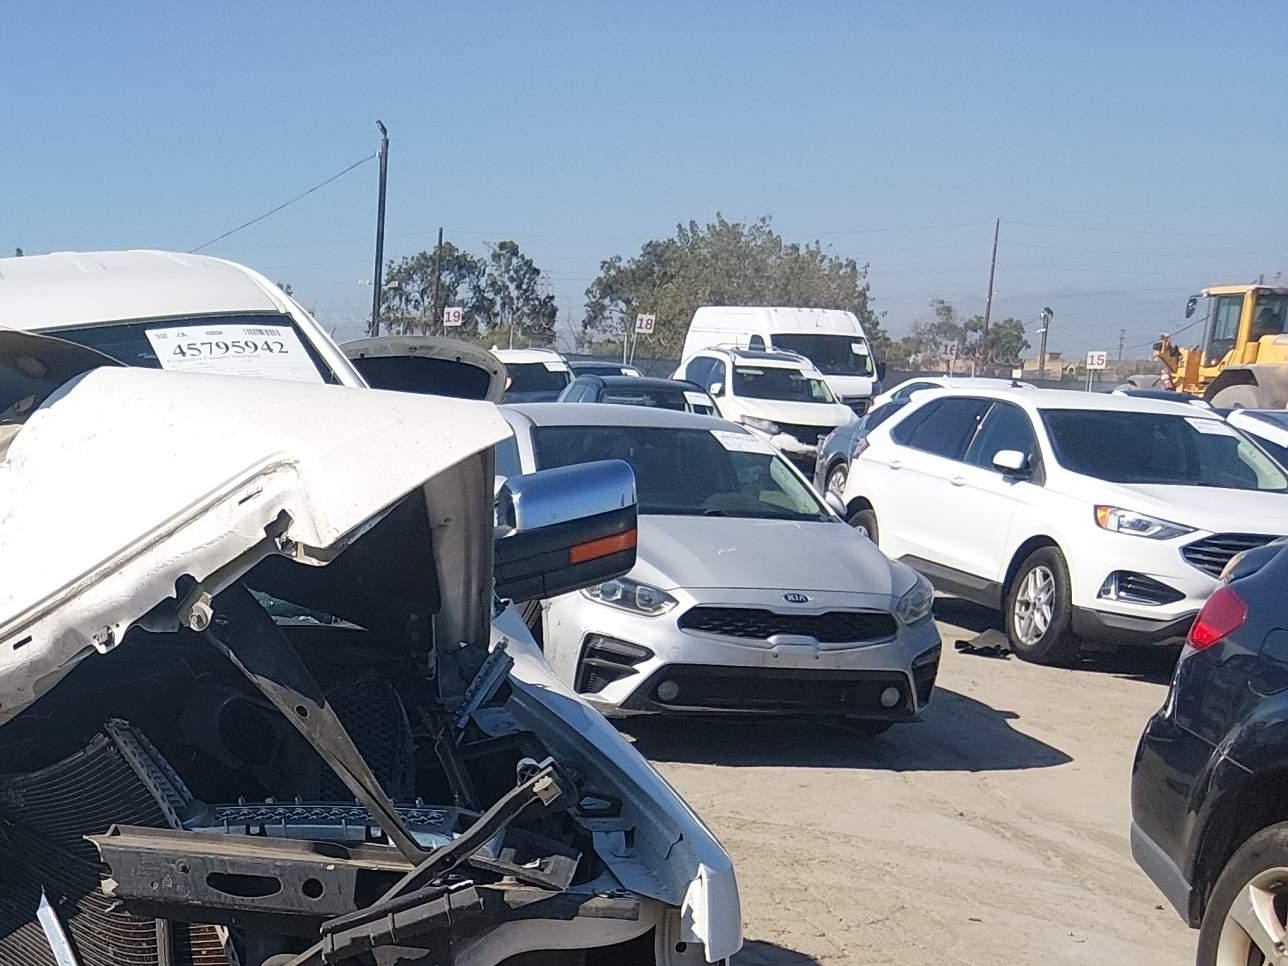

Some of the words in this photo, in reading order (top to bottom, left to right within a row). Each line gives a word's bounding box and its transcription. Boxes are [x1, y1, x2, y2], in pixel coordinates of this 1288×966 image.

[444, 311, 461, 323] 19
[636, 318, 653, 330] 18
[172, 340, 289, 357] 45795942
[1088, 354, 1105, 366] 15
